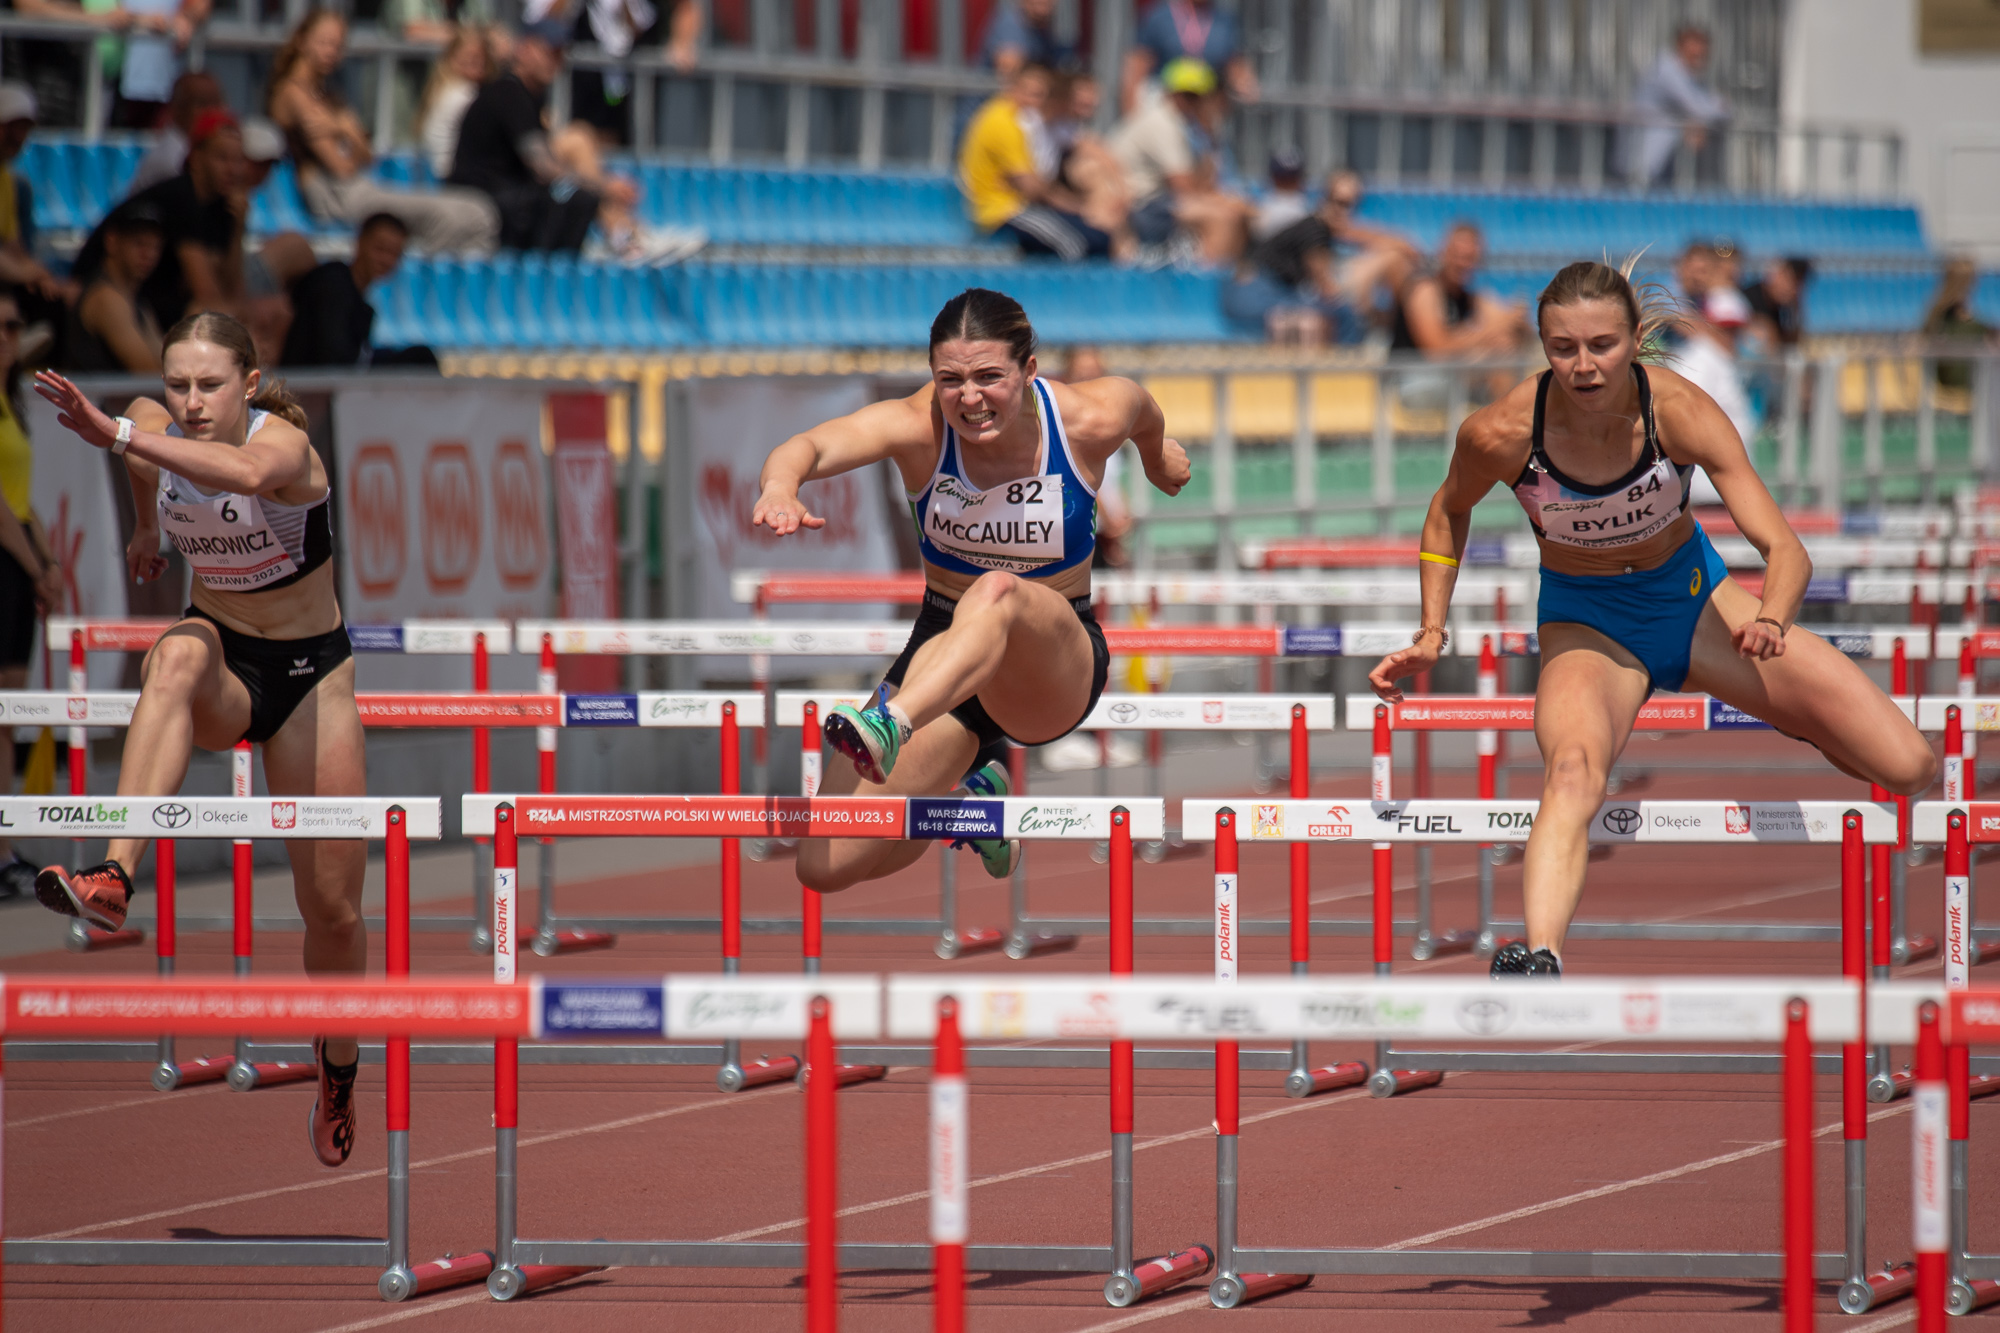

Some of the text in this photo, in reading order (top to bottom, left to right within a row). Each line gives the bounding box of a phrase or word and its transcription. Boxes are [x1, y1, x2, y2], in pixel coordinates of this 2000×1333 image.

[935, 478, 988, 509] Europol
[1006, 480, 1044, 504] 82
[1627, 473, 1663, 503] 84
[221, 501, 239, 523] 6
[1542, 501, 1605, 512] Europol
[164, 507, 195, 523] FUEL
[1572, 504, 1655, 532] BYLIK
[932, 511, 1054, 544] McCAULEY
[1561, 535, 1639, 548] WARSZAWA
[1642, 517, 1668, 538] 2023
[200, 565, 282, 585] ARSZAWA 2023
[931, 597, 954, 612] ARMO
[289, 666, 314, 676] erima
[371, 705, 407, 716] POLSKI
[408, 705, 419, 716] W
[1433, 710, 1508, 720] MISTRZOSTWA
[1510, 710, 1535, 720] POLS
[38, 803, 128, 822] TOTALbet
[202, 810, 248, 824] Okęcie
[302, 806, 352, 815] Ministerstwo
[569, 809, 661, 822] MISTRZOSTWA
[664, 810, 709, 822] POLSKI
[711, 810, 725, 822] W
[727, 810, 820, 823] WIELOBOJACH
[823, 811, 852, 825] U20,
[854, 812, 883, 825] U23,
[885, 812, 894, 823] S
[926, 808, 987, 819] WARSZAWA
[1756, 811, 1808, 819] Ministerstwo
[302, 817, 329, 828] Sportu
[917, 822, 997, 833] 16-18 CZERWCA
[1377, 810, 1463, 833] 4F FUEL
[1488, 812, 1534, 829] TOTA
[1655, 815, 1702, 830] Okęcie
[1756, 821, 1785, 831] Sportu
[1981, 817, 2000, 830] PZ
[1309, 826, 1351, 837] ORLEN
[496, 897, 509, 955] polanik
[1218, 902, 1233, 962] polanik
[1951, 905, 1965, 965] polanik
